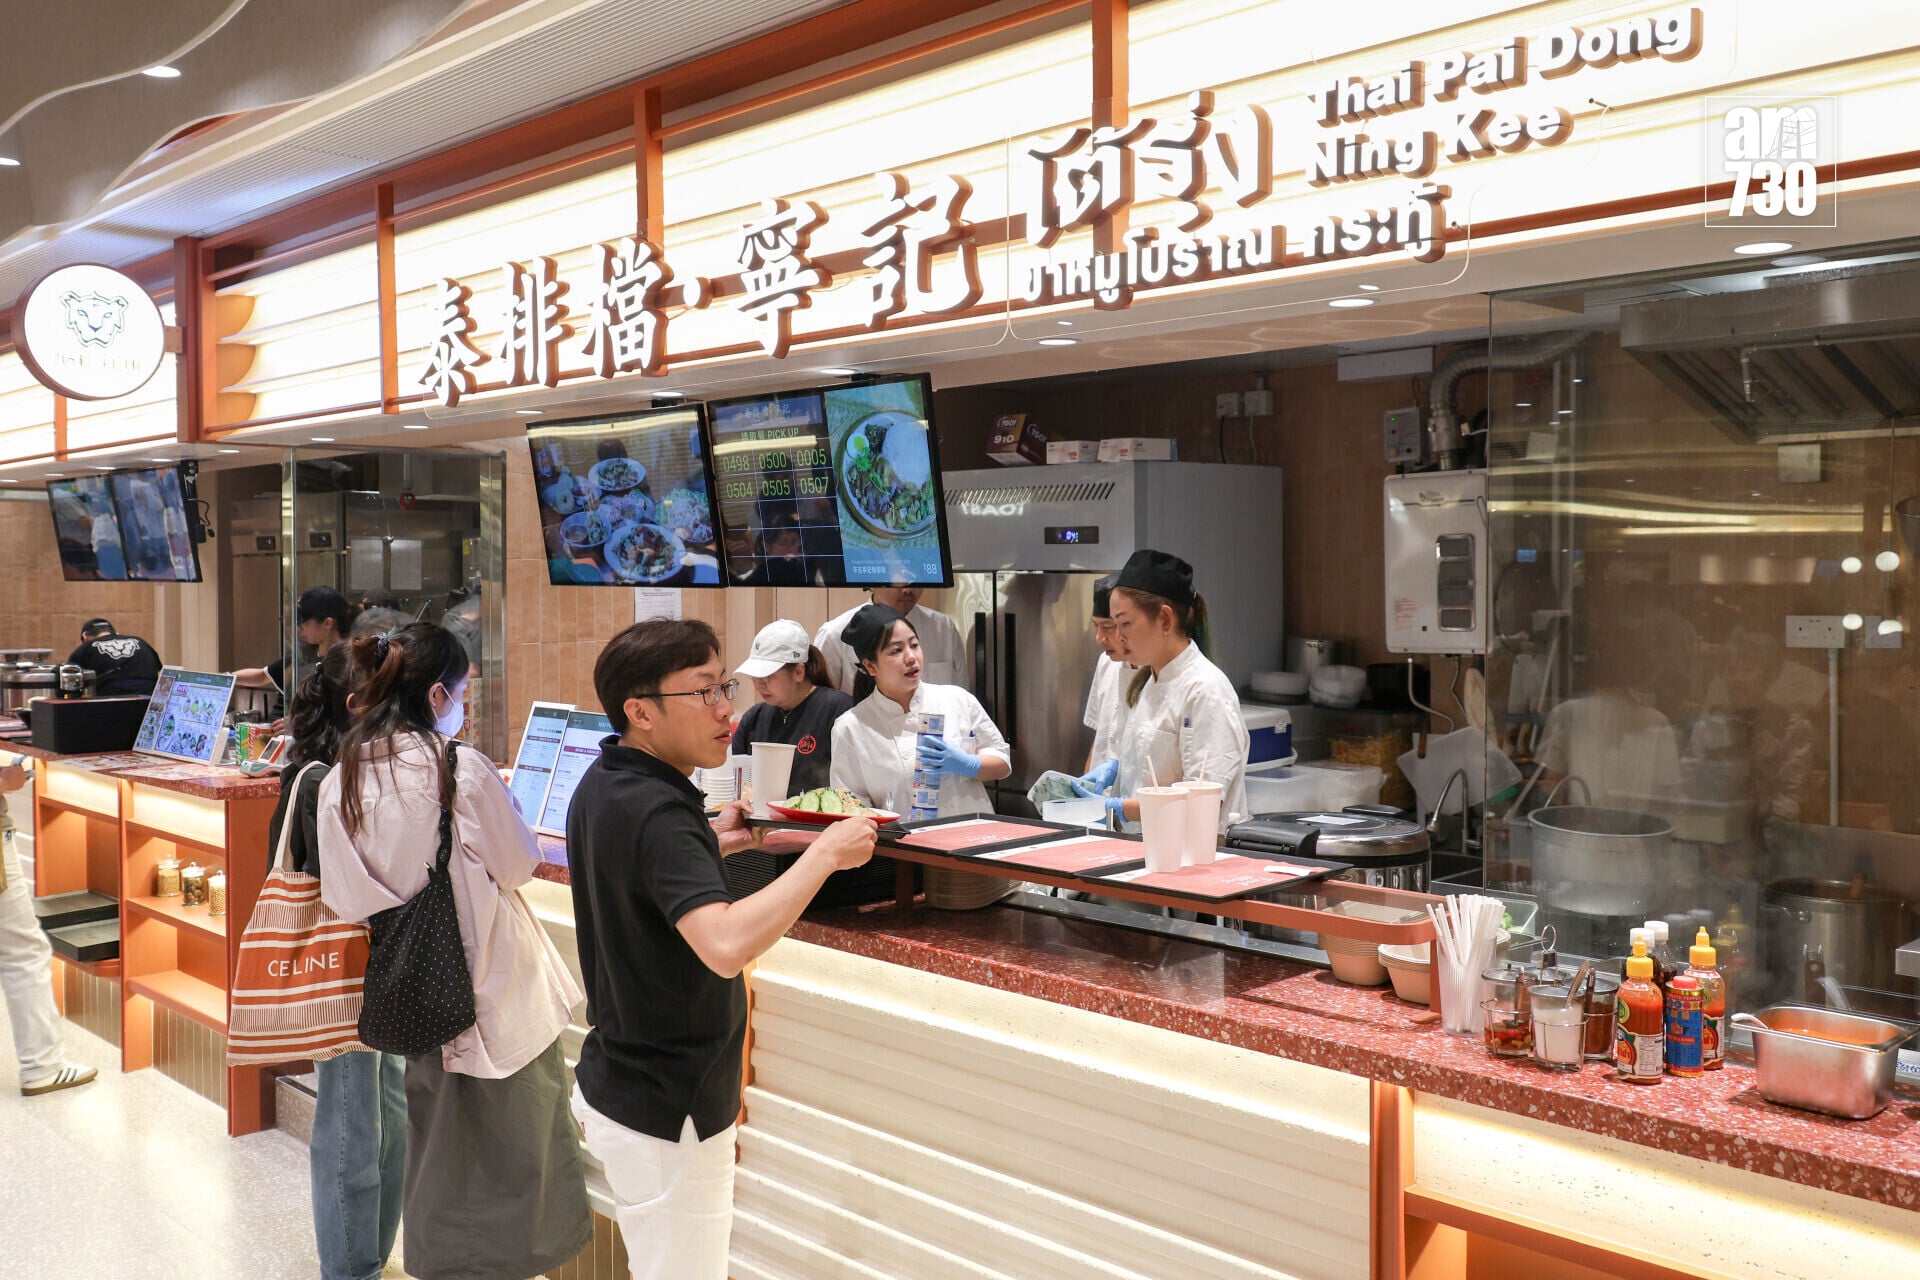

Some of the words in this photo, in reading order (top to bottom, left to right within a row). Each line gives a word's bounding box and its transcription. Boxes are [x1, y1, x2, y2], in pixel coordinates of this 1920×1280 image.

[1308, 60, 1425, 128] Thai
[1434, 36, 1528, 102] Pai
[1539, 8, 1703, 80] Dong
[1307, 130, 1438, 188] Ning
[1446, 107, 1574, 163] Kee
[723, 455, 750, 473] 0498
[759, 451, 787, 470] 0500
[726, 482, 753, 499] 0504
[762, 479, 791, 497] 0505
[800, 476, 829, 495] 0507
[267, 952, 341, 977] CELINE
